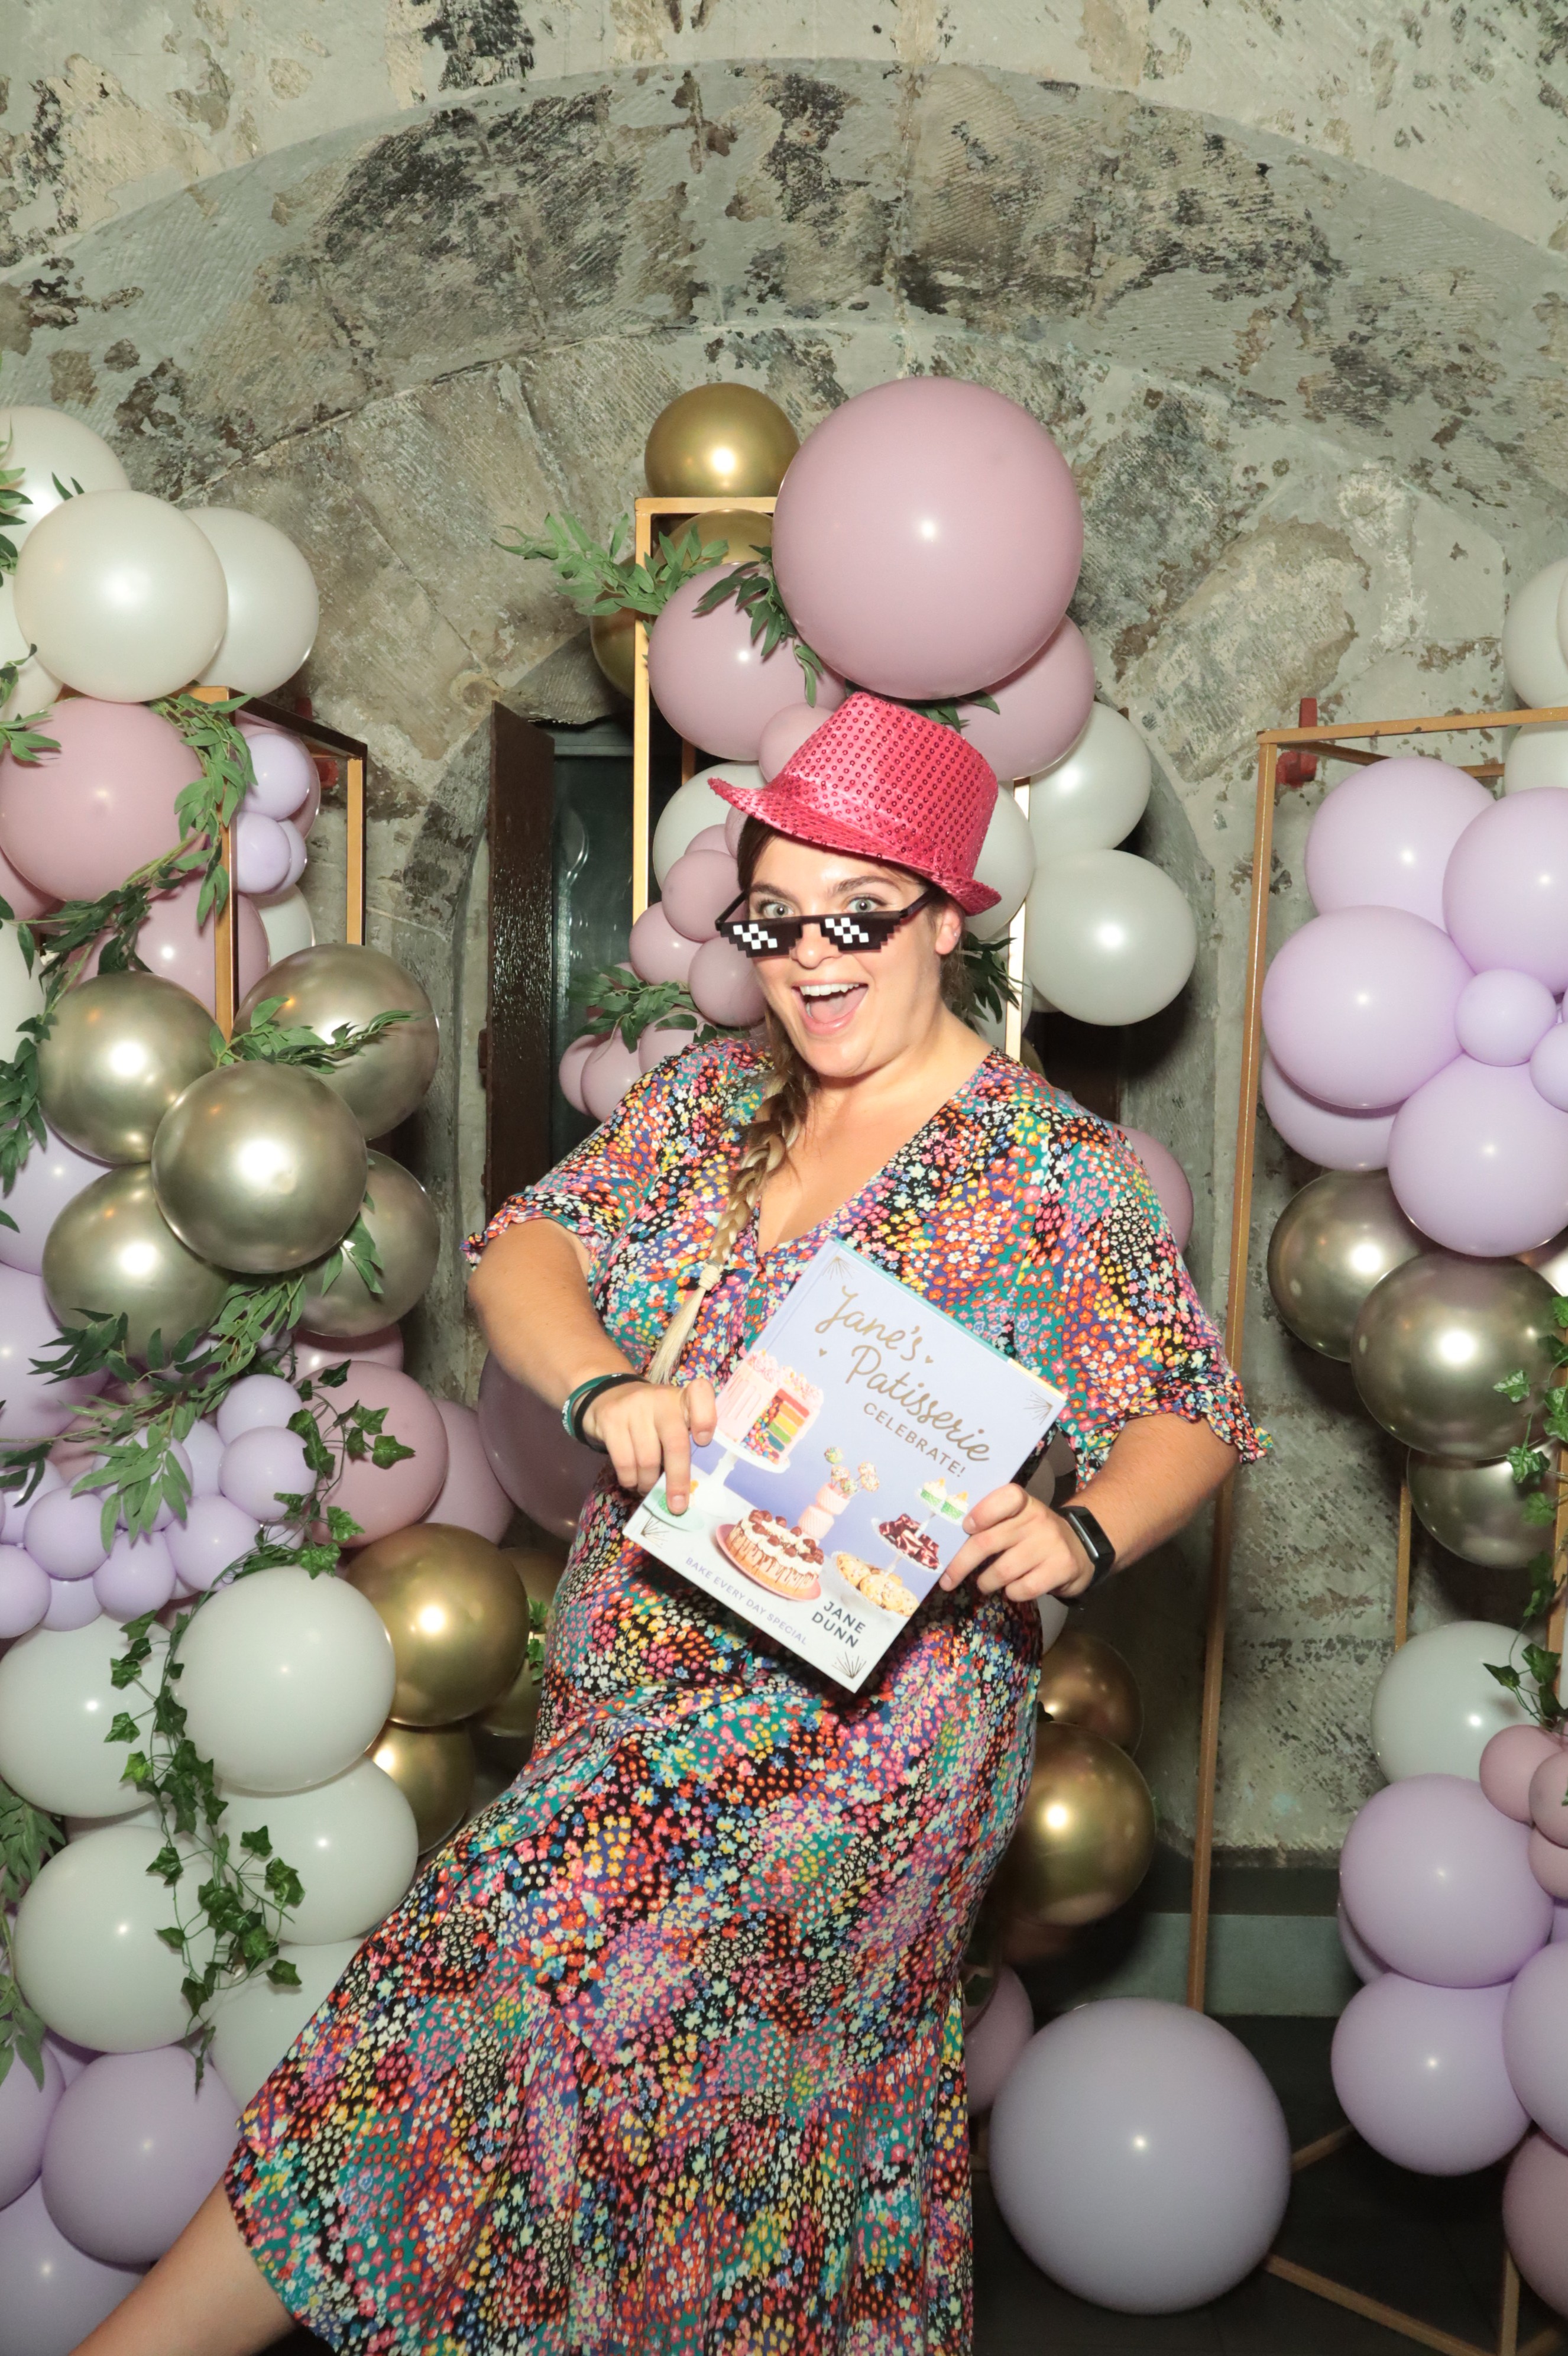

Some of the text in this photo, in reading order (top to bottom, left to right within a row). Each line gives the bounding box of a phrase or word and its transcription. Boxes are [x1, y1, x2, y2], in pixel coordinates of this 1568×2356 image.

[815, 1285, 922, 1361] Jane's
[845, 1345, 990, 1461] Patisserie
[864, 1403, 966, 1477] CELEBRATE!
[685, 1556, 807, 1645] BAKE EVERY DAY SPECIAL
[811, 1611, 859, 1648] DUNN
[824, 1601, 866, 1634] JANE
